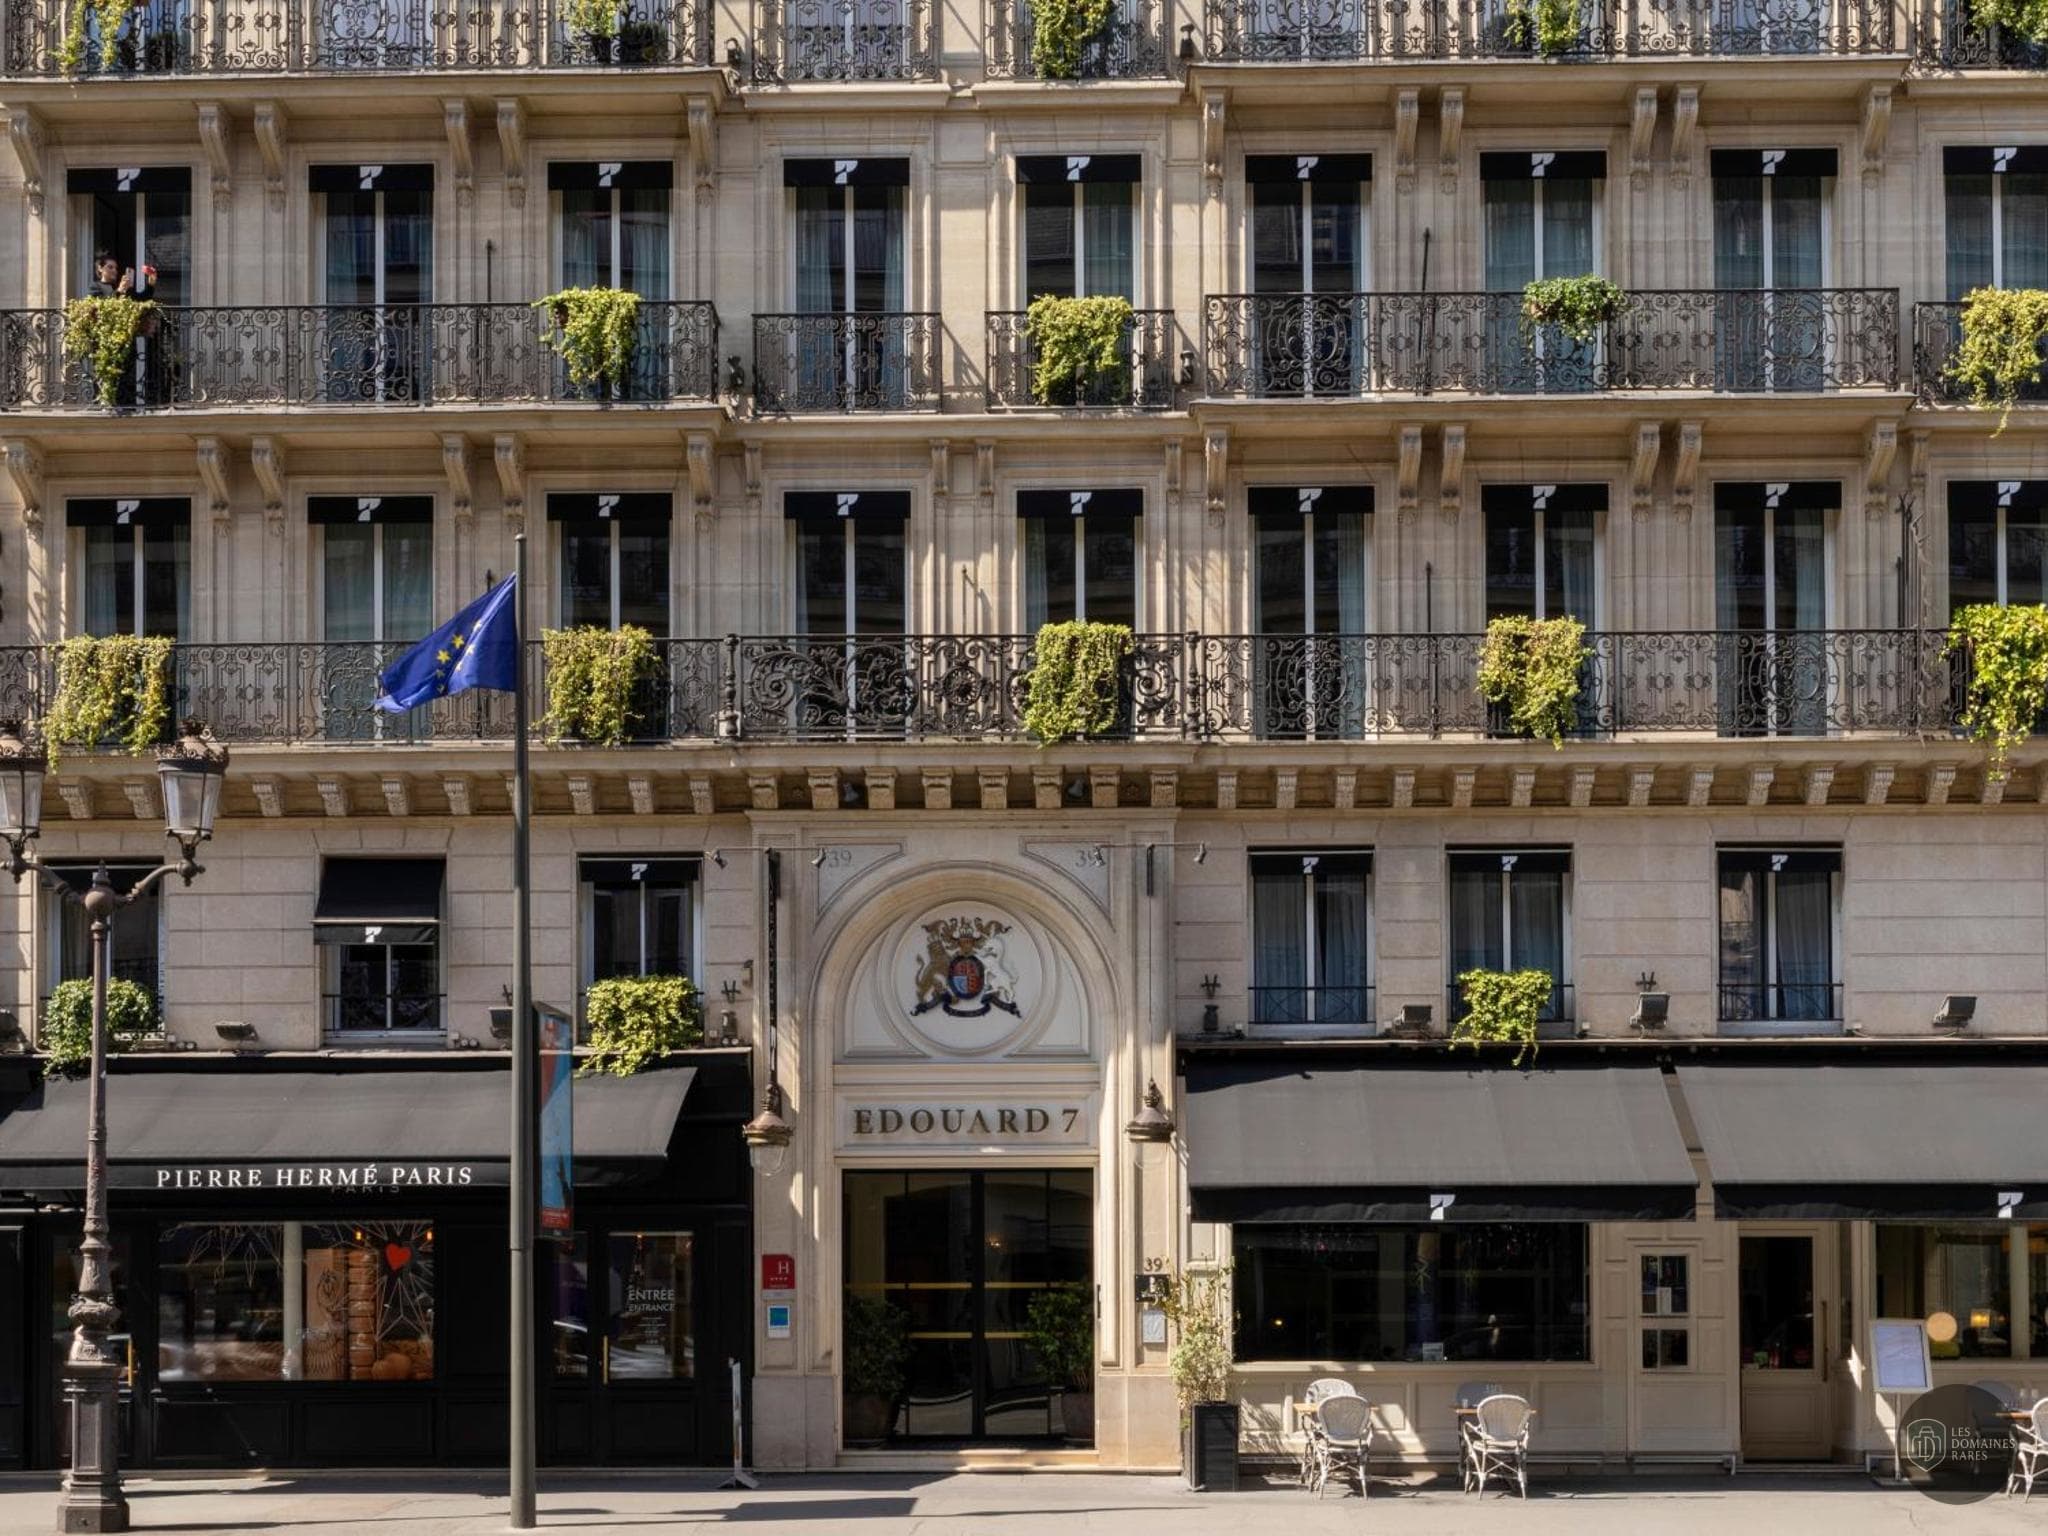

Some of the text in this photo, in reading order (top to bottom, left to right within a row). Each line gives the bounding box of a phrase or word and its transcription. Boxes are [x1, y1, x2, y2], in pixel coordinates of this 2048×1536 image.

[853, 1107, 1079, 1134] EDOUARD 7
[156, 1164, 473, 1188] PIERRE HERMÉ PARIS
[778, 1261, 790, 1274] H
[1144, 1256, 1163, 1272] 39
